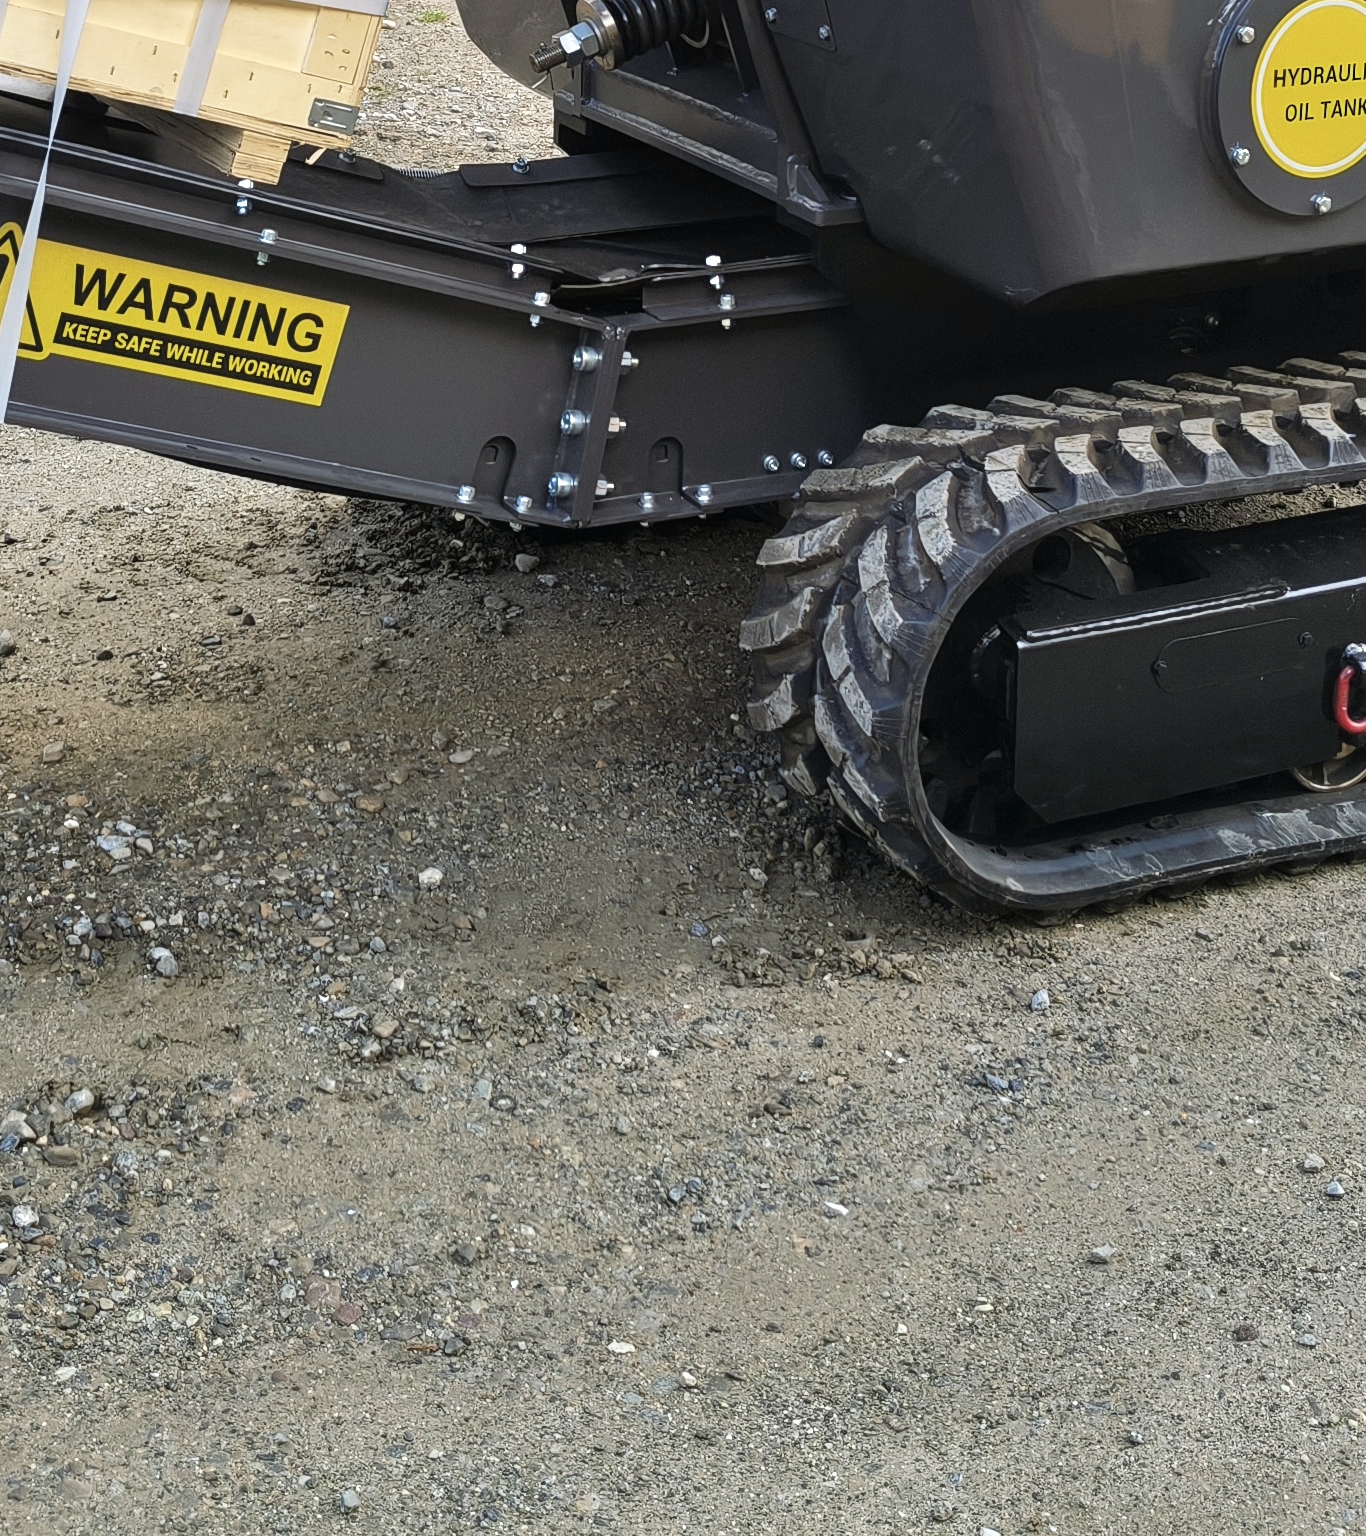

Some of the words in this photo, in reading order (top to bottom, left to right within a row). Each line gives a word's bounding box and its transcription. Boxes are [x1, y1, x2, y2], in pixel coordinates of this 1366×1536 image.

[1285, 102, 1314, 123] OIL
[73, 263, 325, 353] WARNING
[61, 321, 111, 345] KEEP
[114, 332, 161, 357] SAFE
[166, 342, 223, 369] WHILE
[228, 355, 314, 387] WORKING
